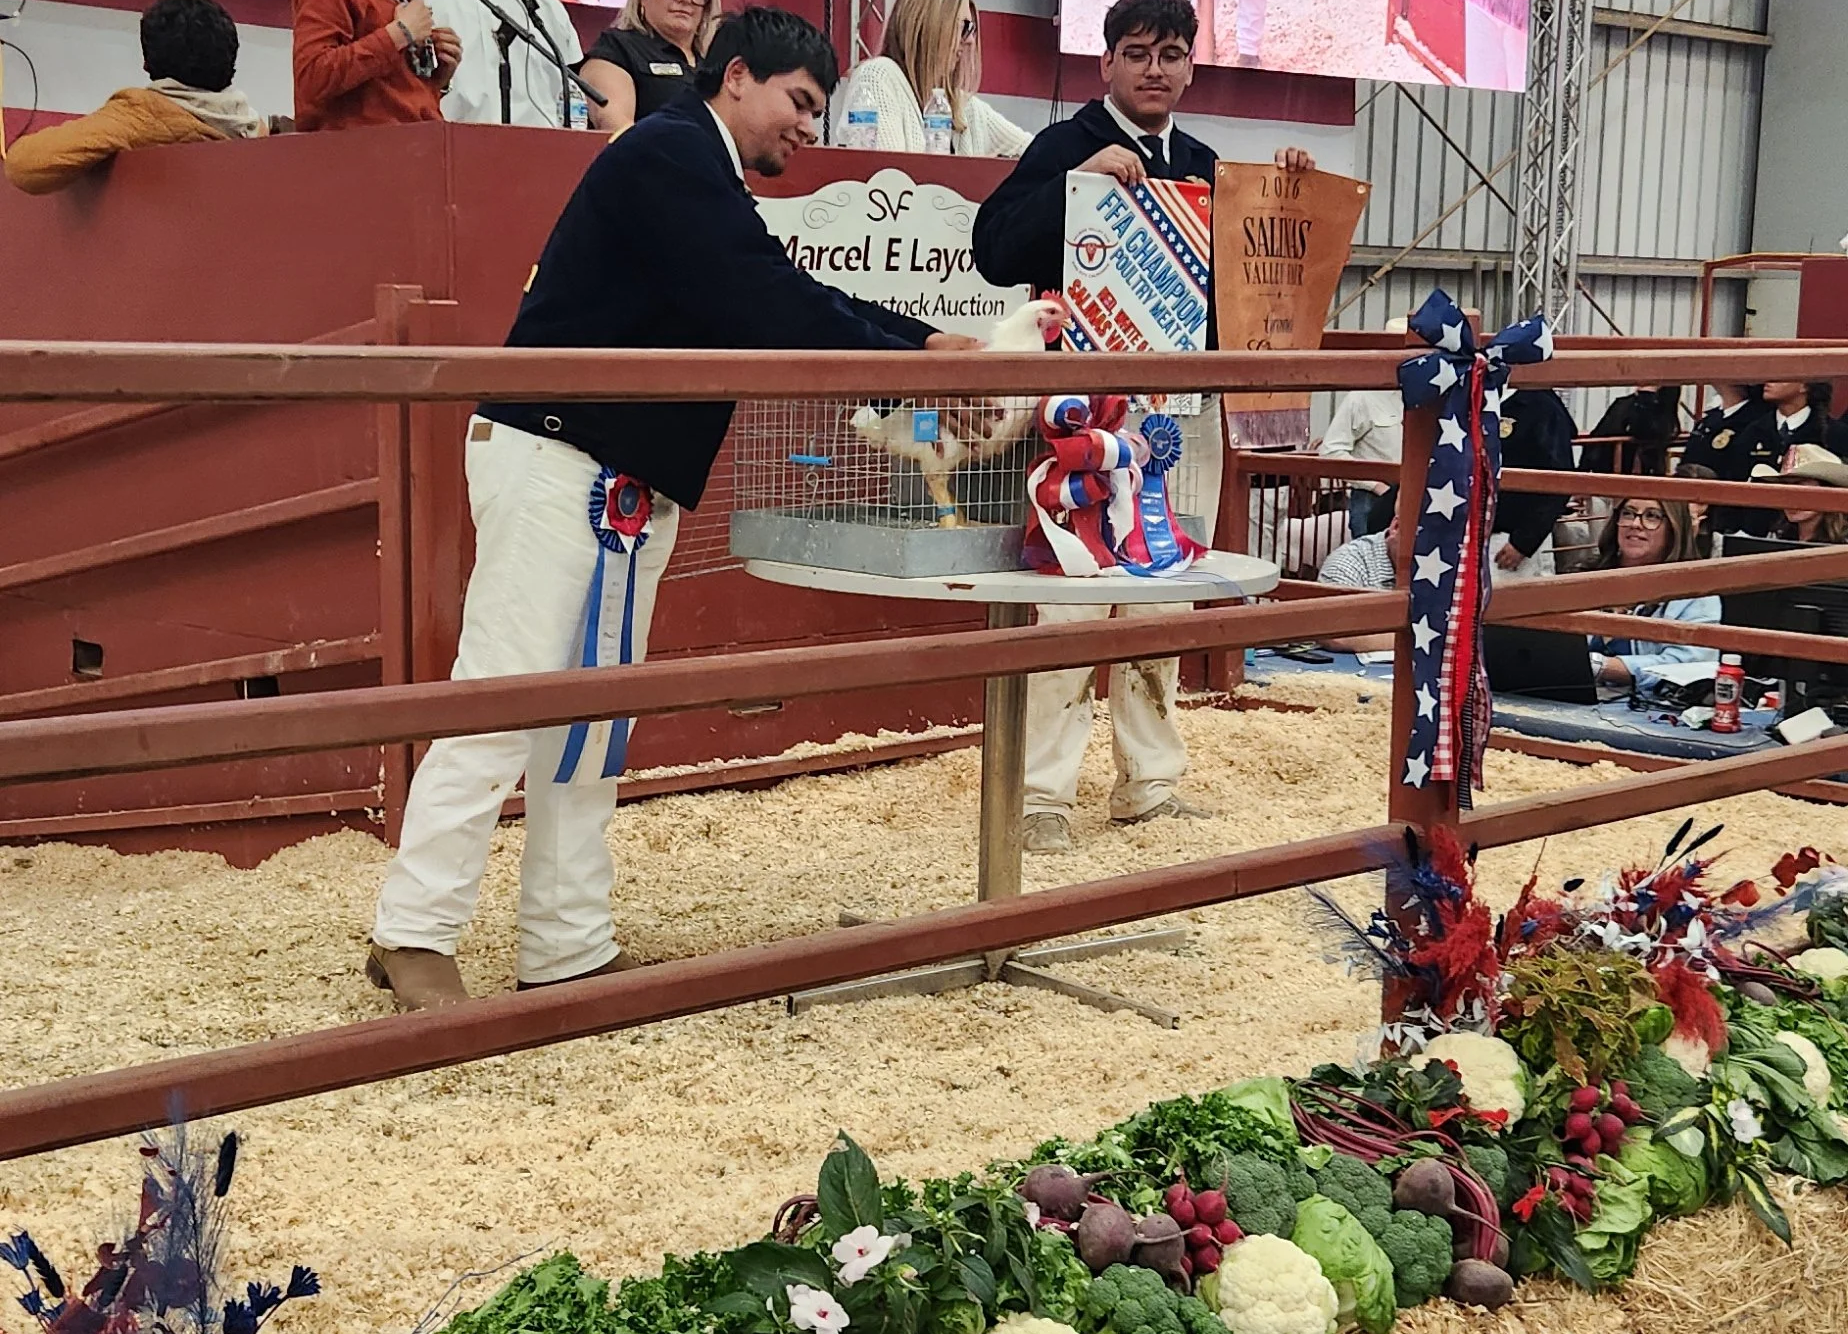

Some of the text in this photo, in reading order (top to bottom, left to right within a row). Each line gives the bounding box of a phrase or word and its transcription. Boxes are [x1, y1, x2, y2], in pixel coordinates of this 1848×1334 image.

[866, 188, 913, 221] SVF
[1243, 216, 1312, 259] SALINAS
[885, 238, 902, 272] E
[910, 238, 976, 283] Layo
[1096, 188, 1207, 334] FFA CHAMPION
[932, 293, 1005, 316] Auction
[1067, 279, 1112, 338] SALINAS
[1109, 247, 1197, 351] POULTRY MEAT PE
[1113, 308, 1144, 346] WHITE
